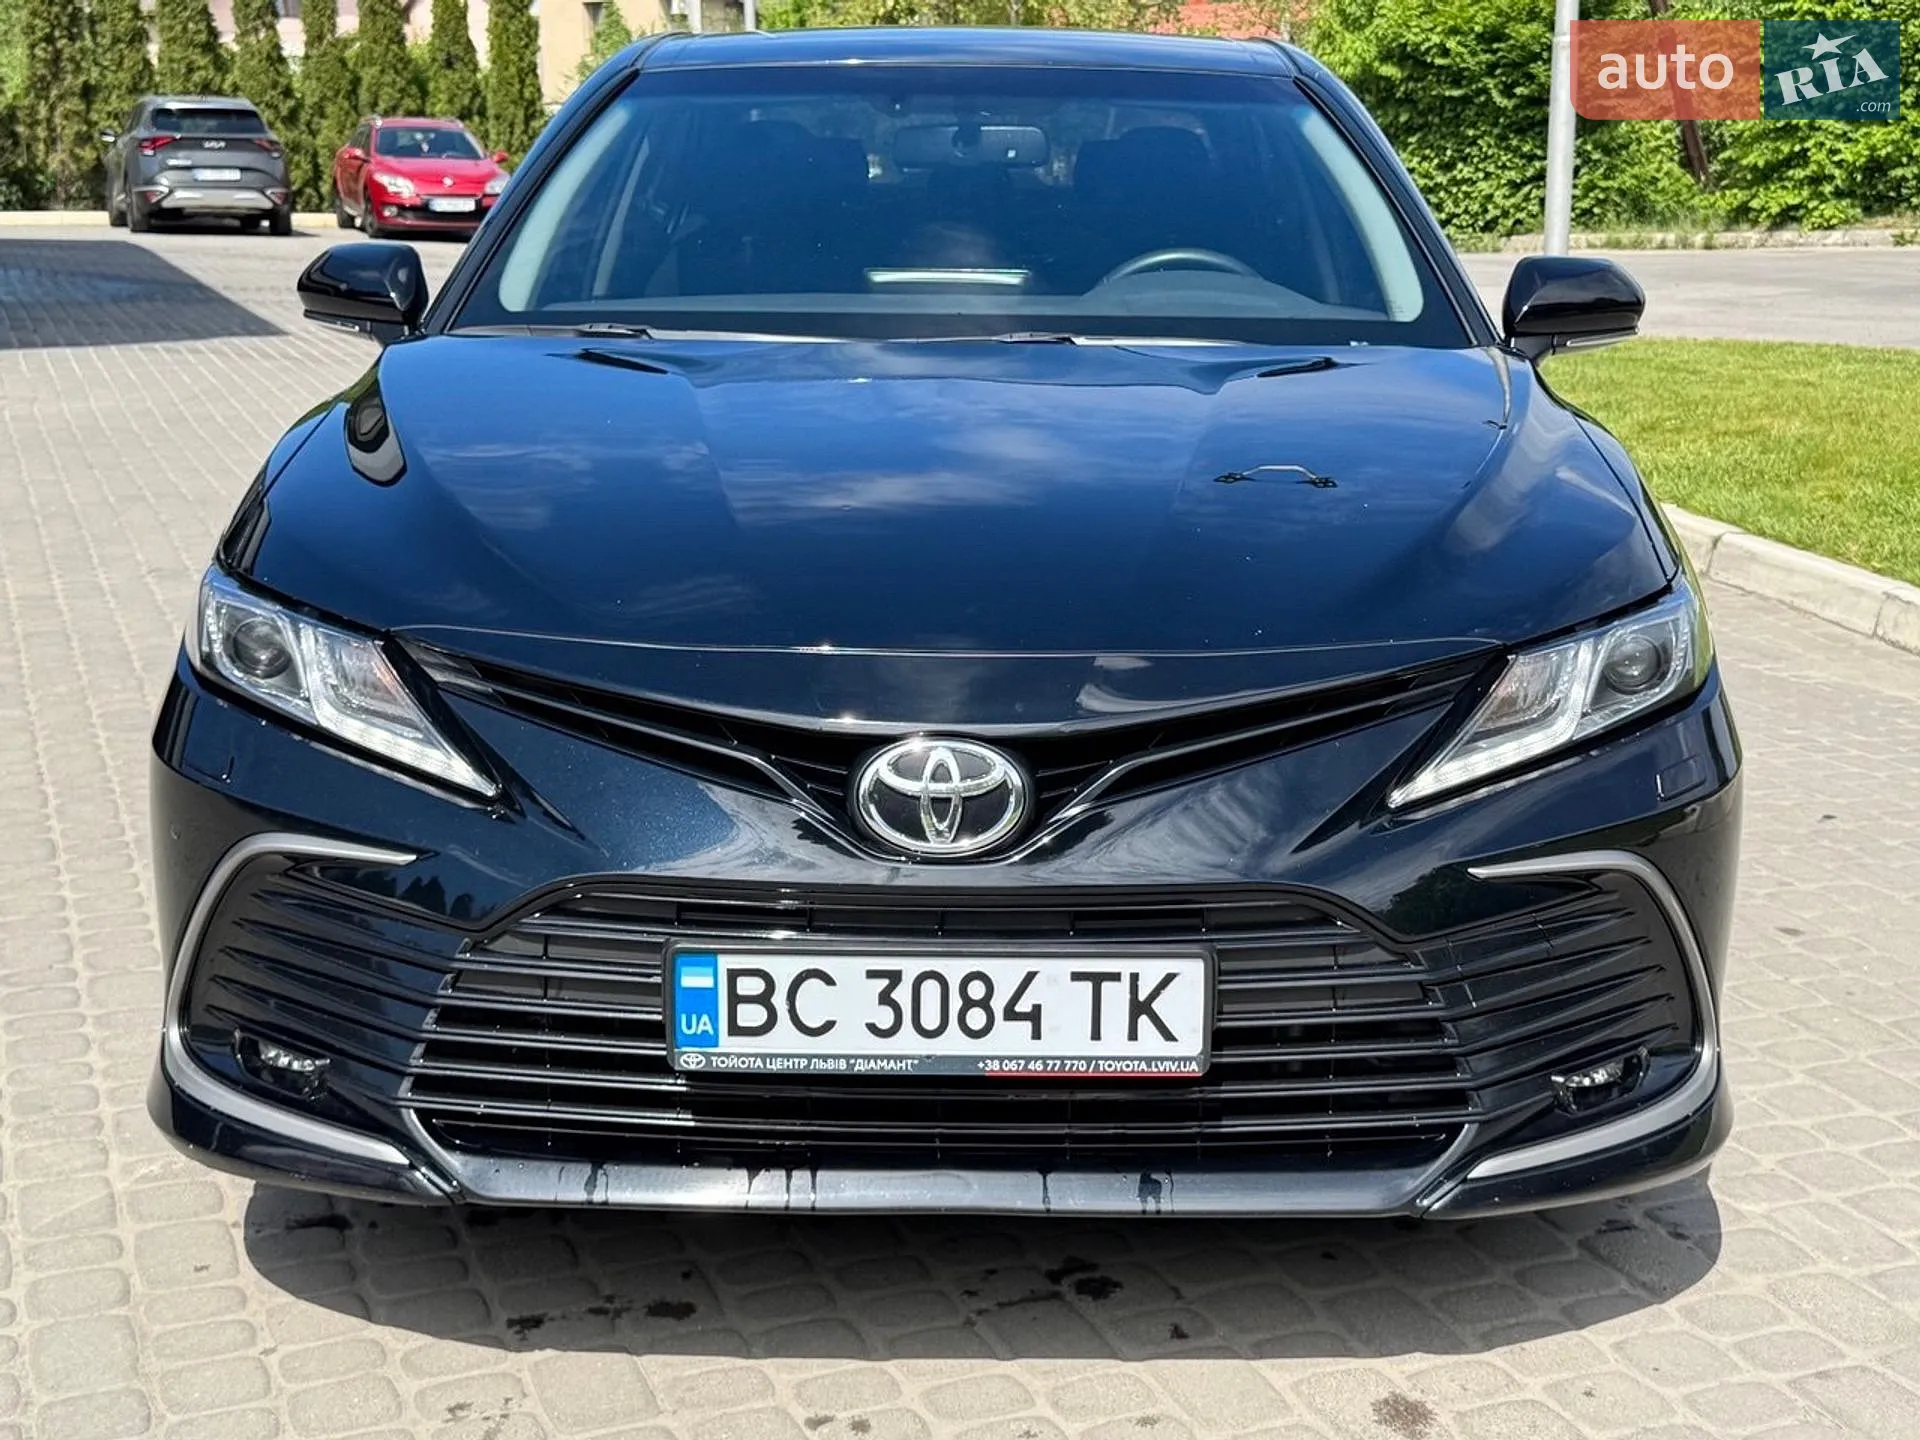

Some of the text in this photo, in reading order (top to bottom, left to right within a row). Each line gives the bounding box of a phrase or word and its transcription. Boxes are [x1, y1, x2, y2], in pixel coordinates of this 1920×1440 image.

[727, 968, 1180, 1042] BC 3084 TK
[681, 1014, 714, 1035] UA
[710, 1055, 763, 1069] ТОЙОТА
[766, 1057, 807, 1070] ЦЕНТР
[810, 1058, 847, 1070] ЛЬВІВ
[977, 1060, 999, 1071] +38
[1002, 1060, 1025, 1071] 067
[1028, 1060, 1043, 1071] 46
[1046, 1060, 1061, 1071] 77
[1064, 1060, 1087, 1071] 770
[1098, 1060, 1199, 1072] TOYOTA.LVIV.UA
